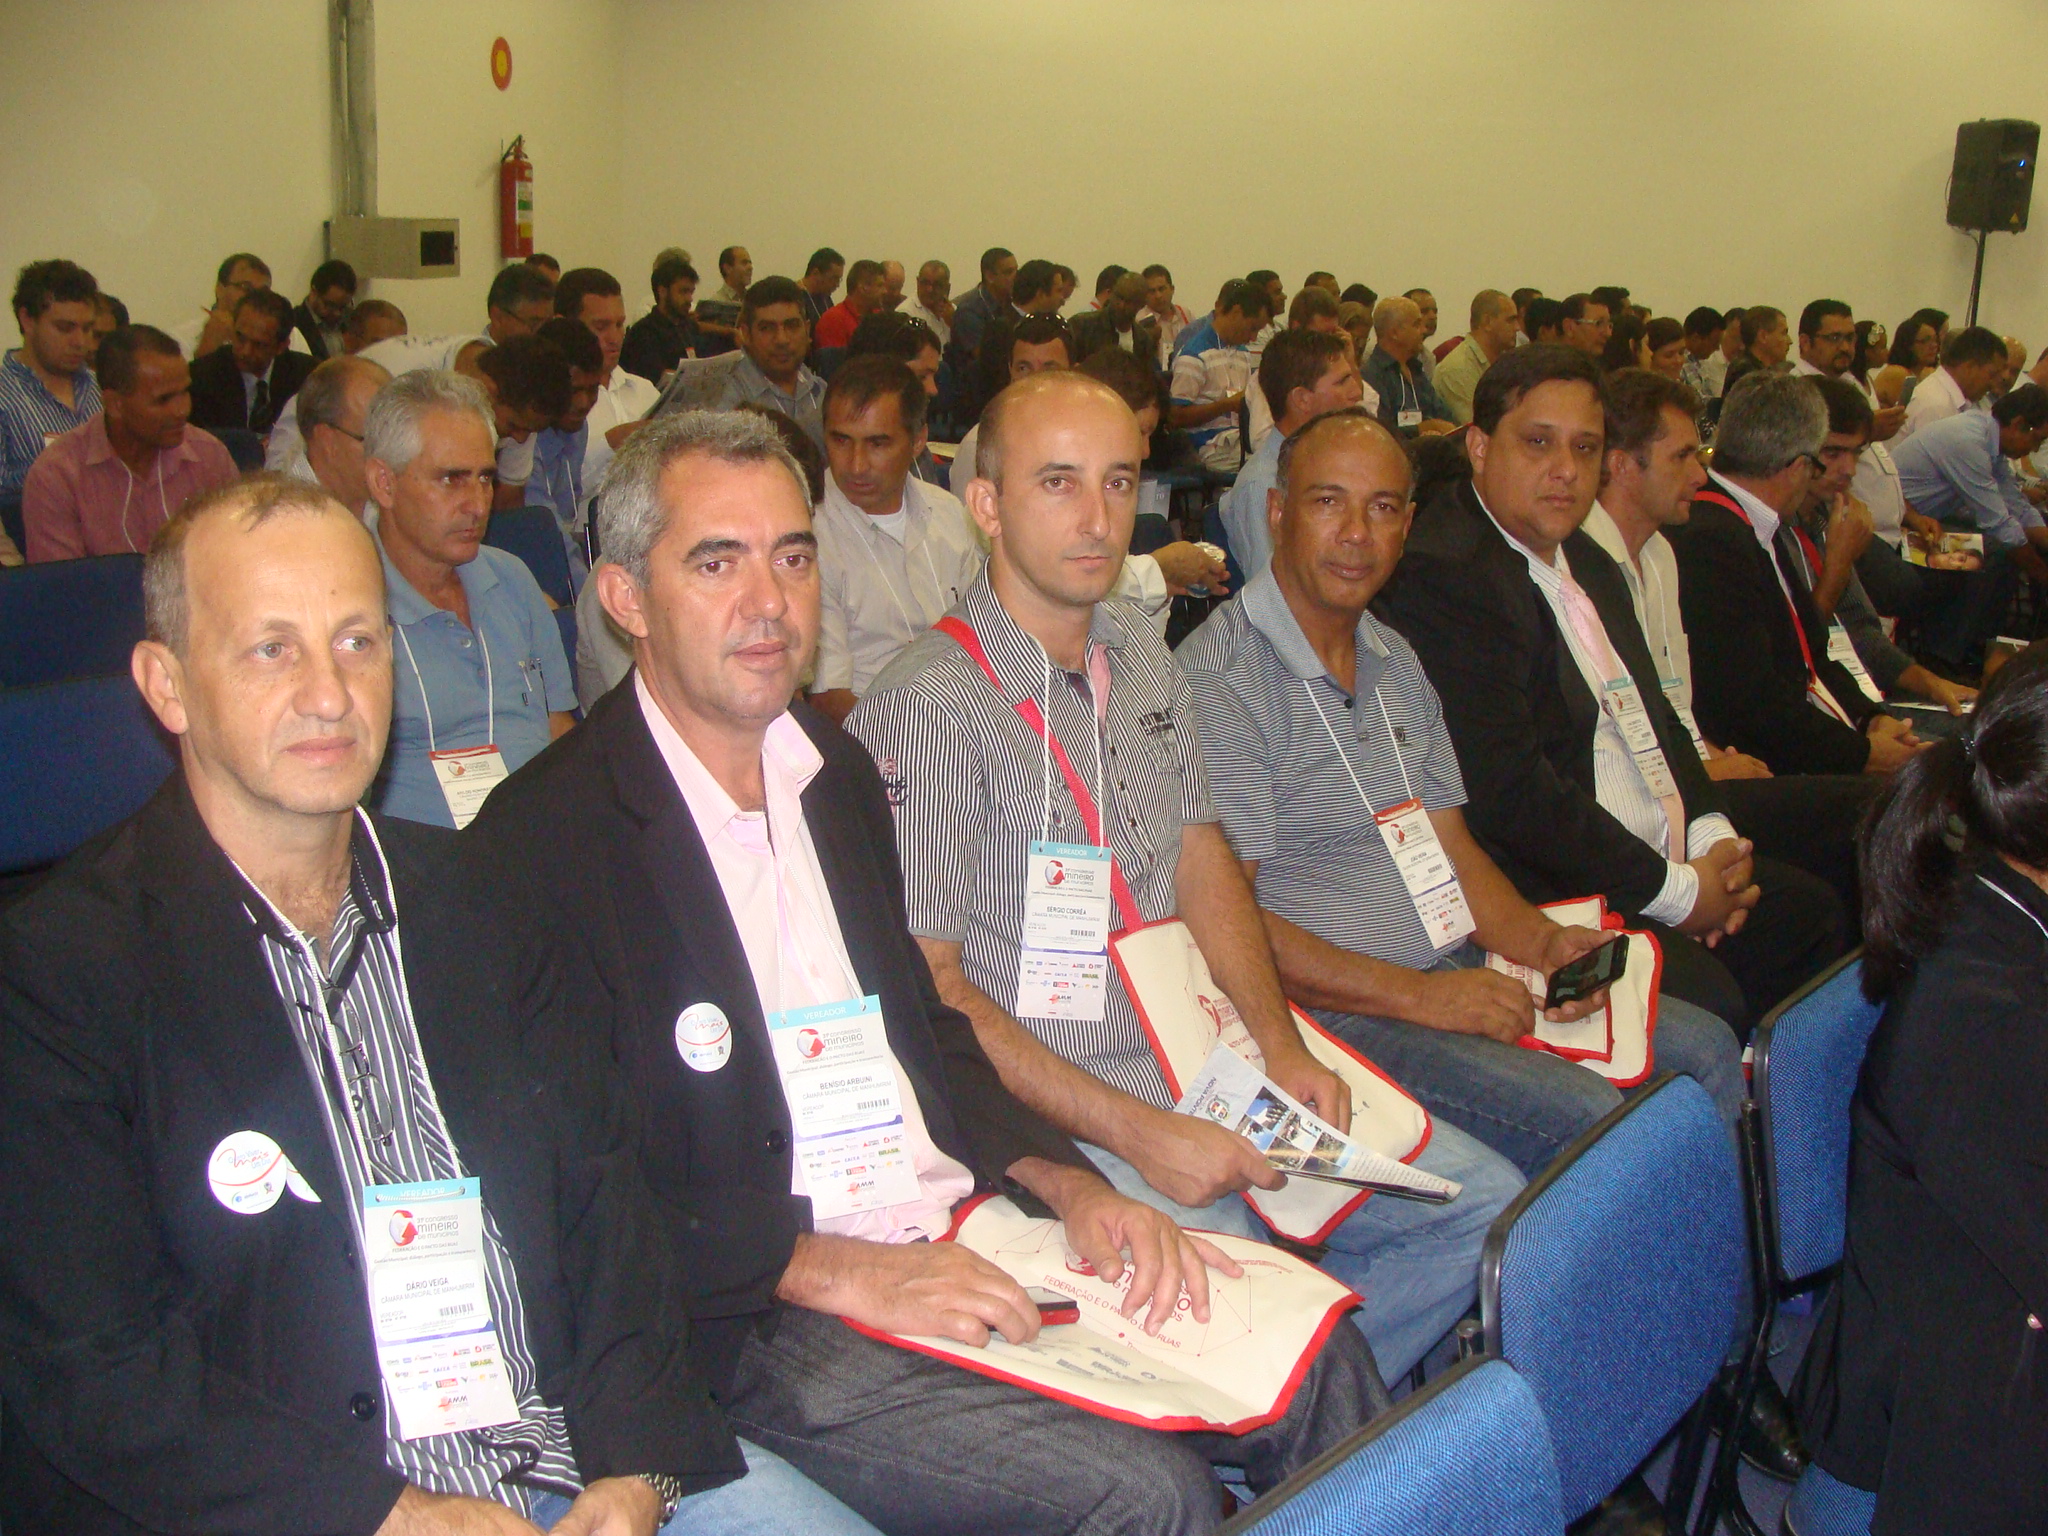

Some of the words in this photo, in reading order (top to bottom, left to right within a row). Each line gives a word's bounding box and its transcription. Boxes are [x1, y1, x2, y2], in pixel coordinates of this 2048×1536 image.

[1056, 847, 1088, 856] VEREADOR
[1046, 905, 1066, 914] SÉRGIO
[803, 1007, 847, 1020] VEREADOR
[802, 1092, 824, 1100] CÂMARA
[824, 1087, 851, 1096] MUNICIPAL
[878, 1148, 901, 1156] BRASIL
[405, 1281, 428, 1291] DÁRIO
[429, 1278, 449, 1287] VEIGA
[380, 1296, 404, 1304] CÂMARA
[404, 1291, 432, 1300] MUNICIPAL
[441, 1283, 475, 1294] MANHUMIRIM
[1043, 1274, 1094, 1305] FEDERAÇÃO
[1094, 1297, 1101, 1305] E
[1102, 1299, 1109, 1309] O
[1109, 1304, 1138, 1326] PAO
[1156, 1333, 1183, 1349] RUAS
[469, 1359, 494, 1368] BRASIL
